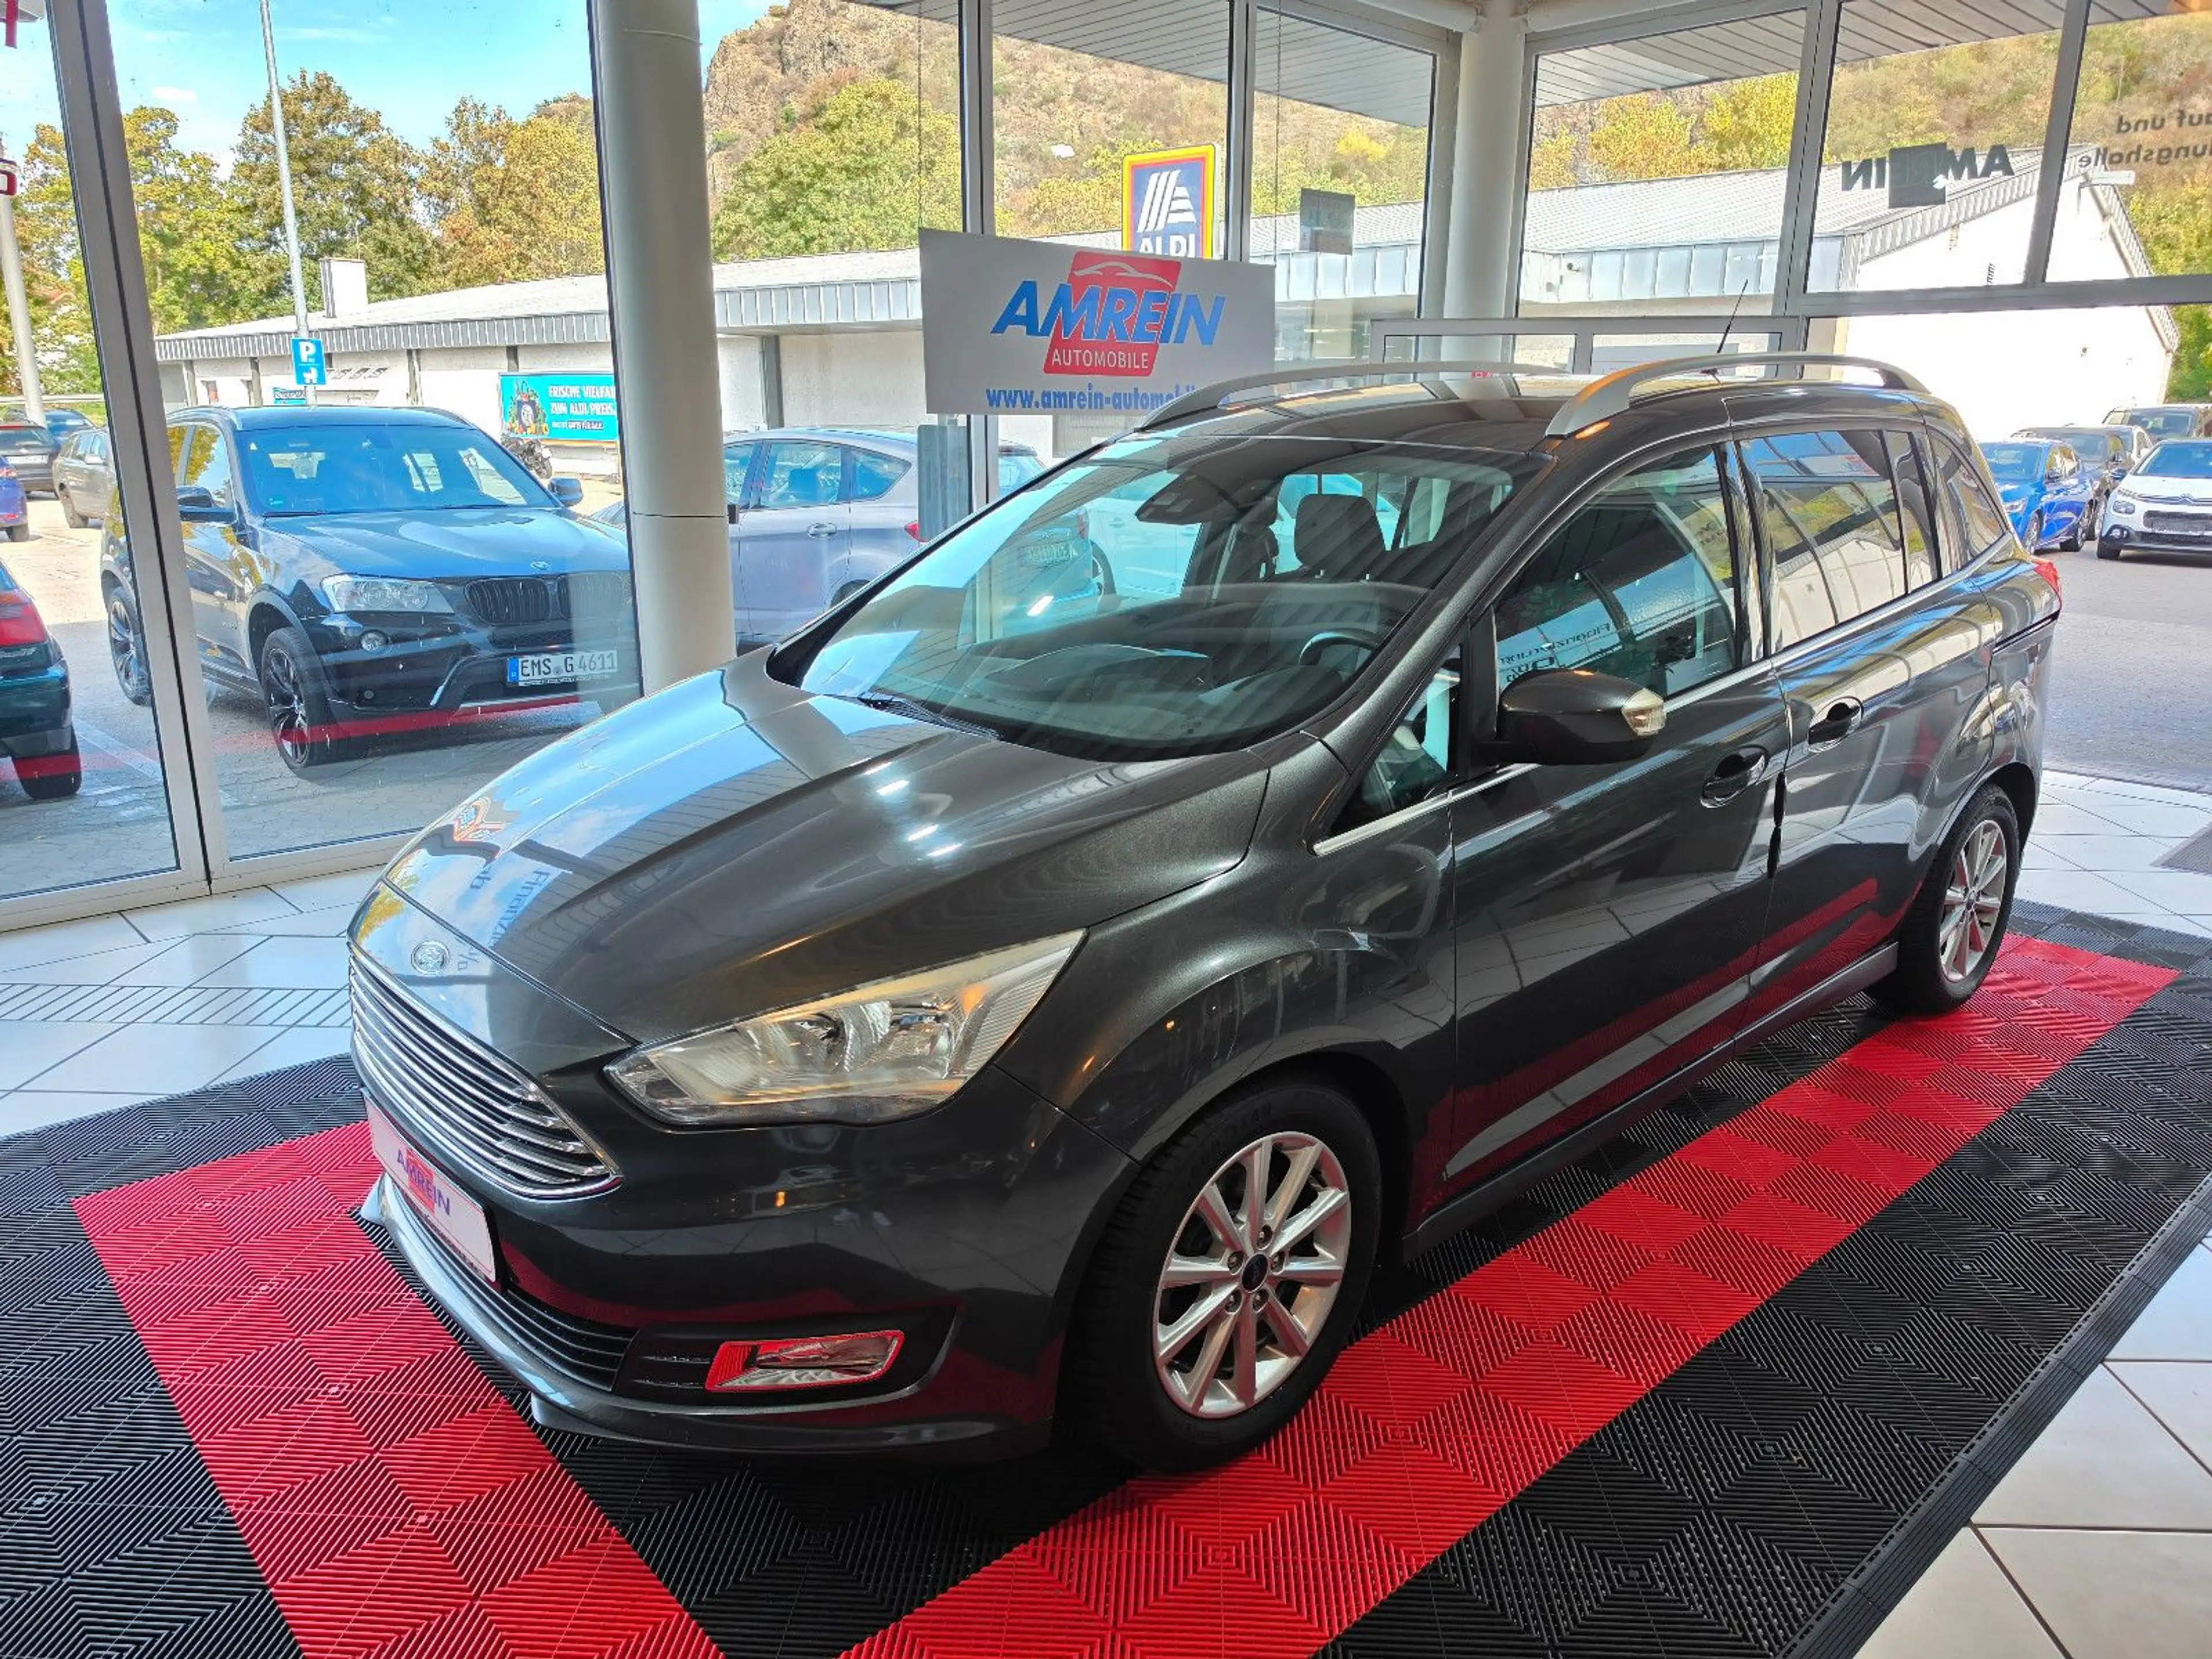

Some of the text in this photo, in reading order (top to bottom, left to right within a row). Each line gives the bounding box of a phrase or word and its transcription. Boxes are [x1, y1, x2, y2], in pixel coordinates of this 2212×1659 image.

[1138, 233, 1195, 257] ALDI
[990, 281, 1226, 346] AMREIN
[298, 341, 316, 363] P
[1051, 349, 1149, 369] AUTOMOBILE
[986, 382, 1196, 410] www.amrein-autom
[521, 653, 616, 677] EMS G 4611
[397, 1149, 450, 1216] AMREIN
